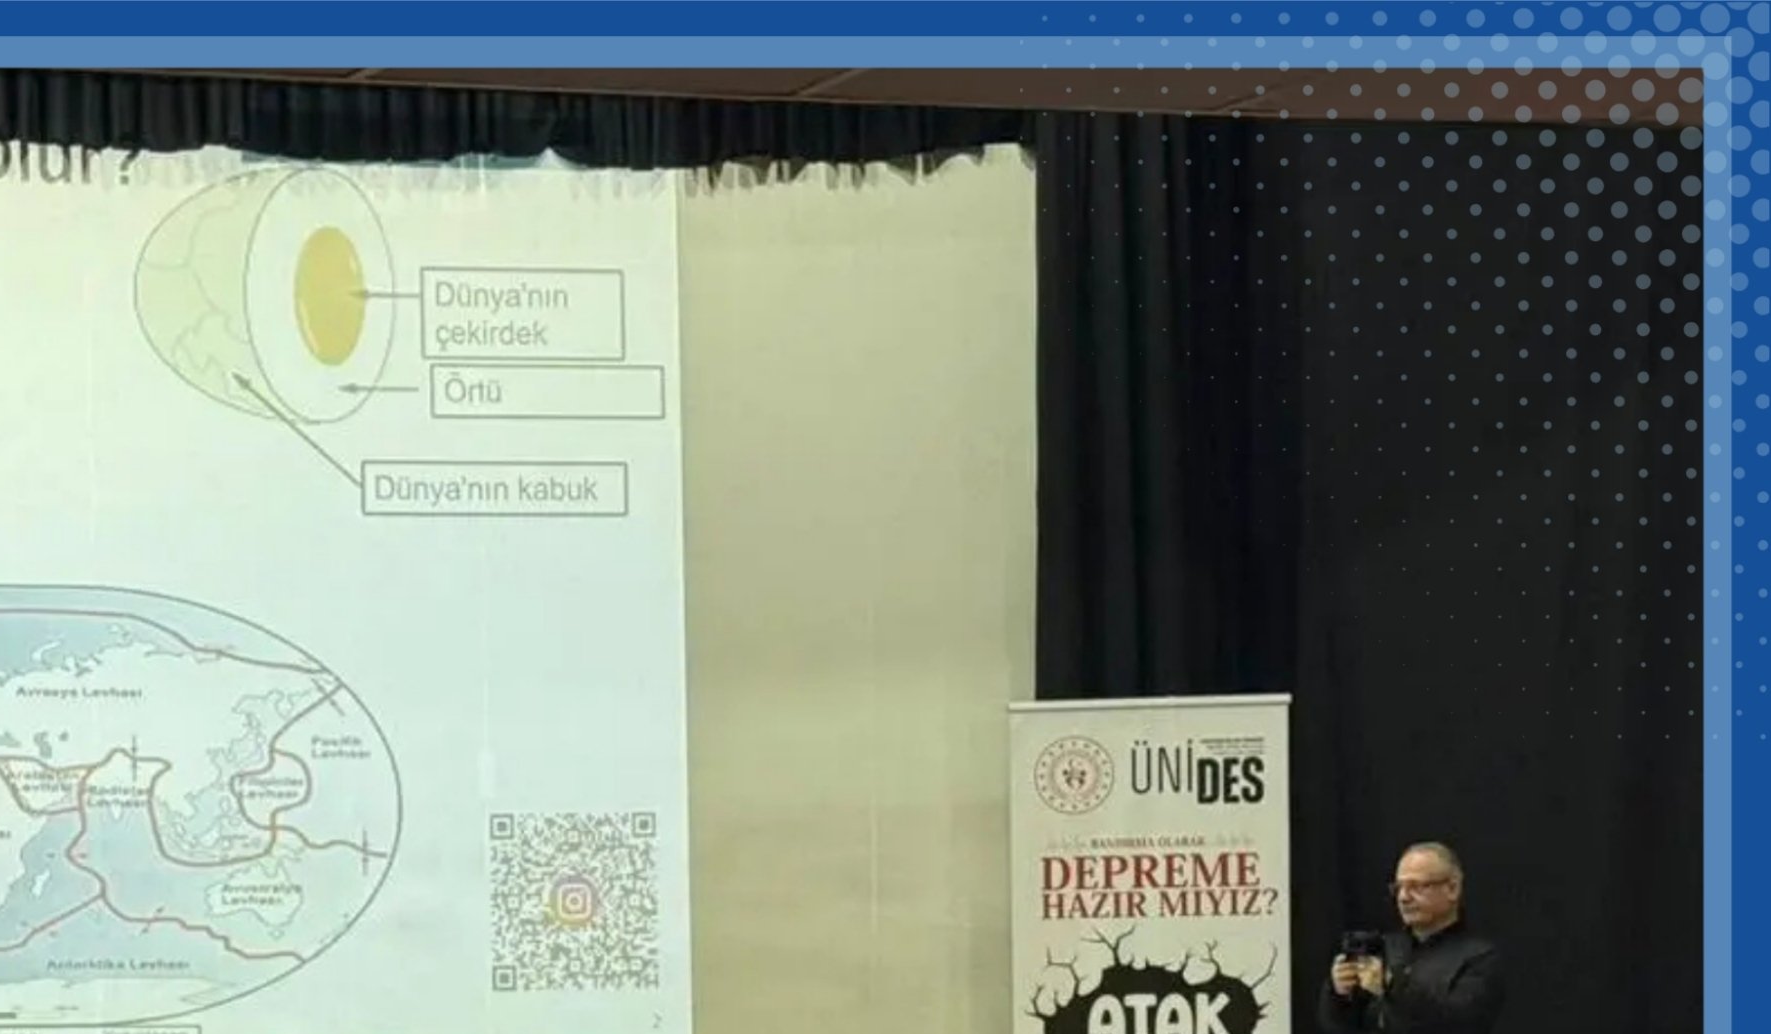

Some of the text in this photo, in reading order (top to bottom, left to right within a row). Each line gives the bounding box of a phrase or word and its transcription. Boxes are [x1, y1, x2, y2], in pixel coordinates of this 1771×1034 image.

[435, 280, 570, 313] Dünya'nın
[435, 320, 549, 350] çekirdek
[374, 474, 599, 507] Dünya'nın kabuk
[1041, 852, 1262, 890] DEPREME
[1042, 887, 1279, 920] HAZIR MIYIZ?
